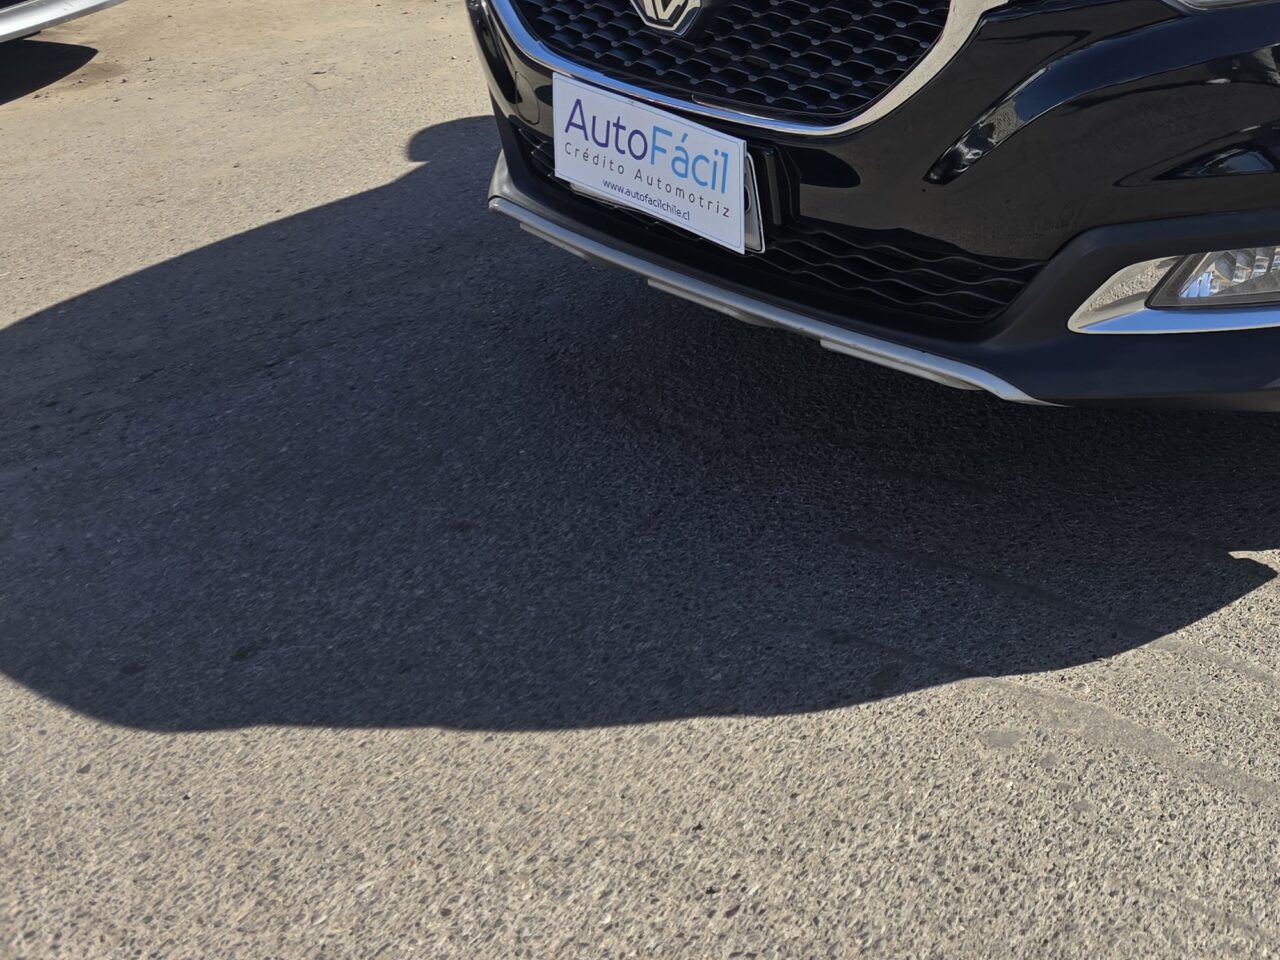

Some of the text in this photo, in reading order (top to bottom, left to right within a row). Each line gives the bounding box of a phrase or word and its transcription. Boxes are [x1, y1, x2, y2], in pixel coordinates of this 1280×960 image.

[564, 98, 729, 194] AutoFácil
[564, 142, 731, 218] Crédito Automotriz
[602, 178, 691, 222] www.autofacilchile.cl
